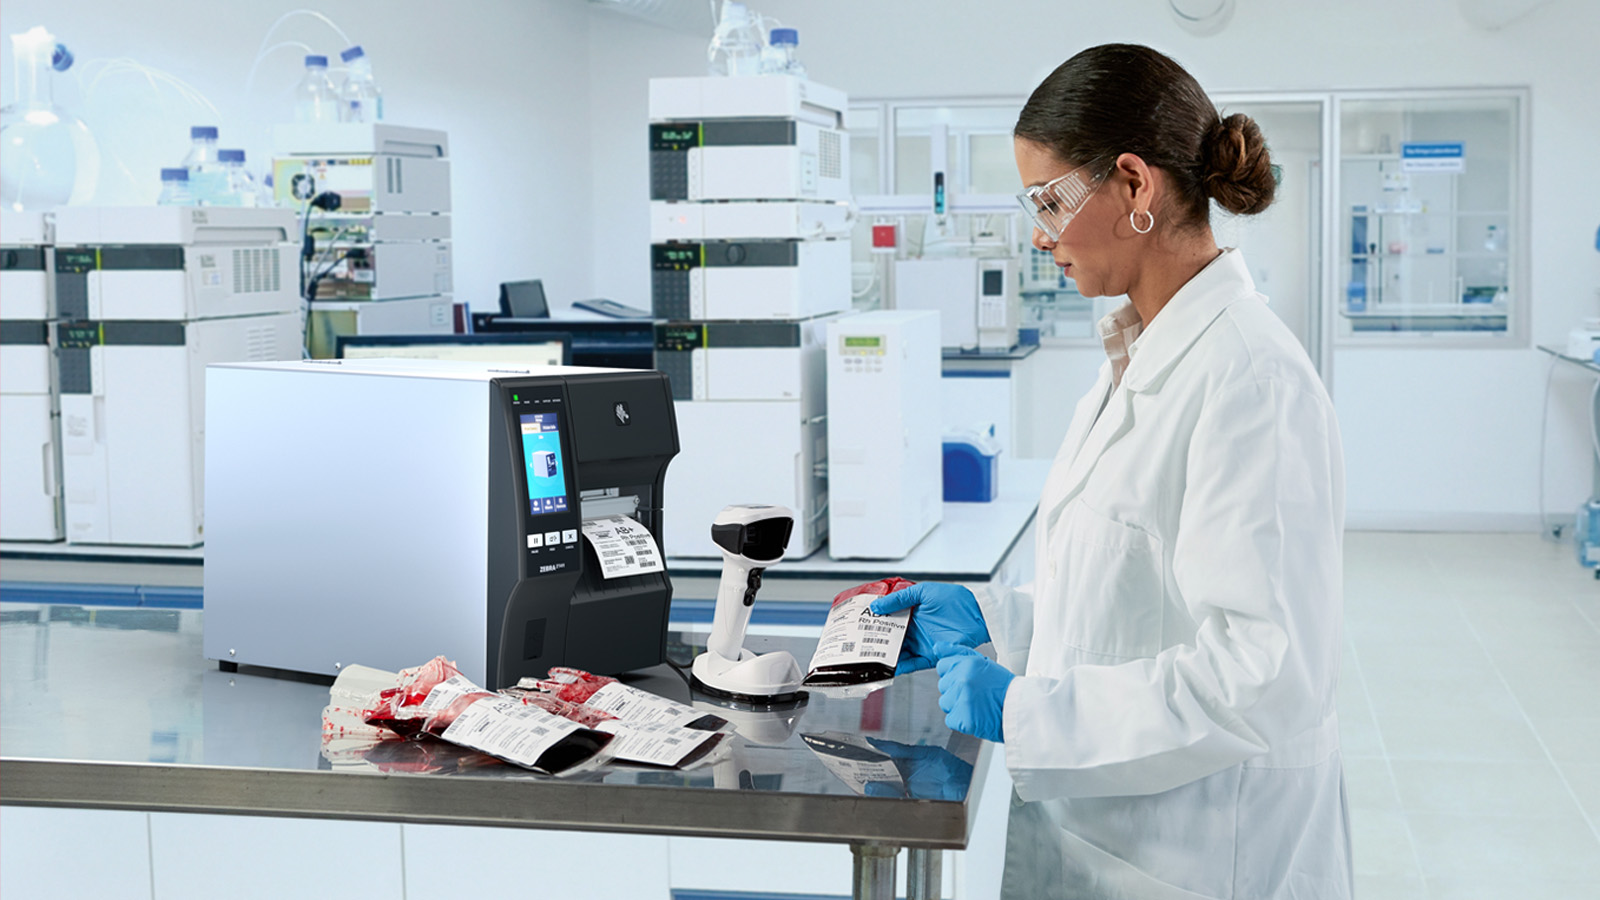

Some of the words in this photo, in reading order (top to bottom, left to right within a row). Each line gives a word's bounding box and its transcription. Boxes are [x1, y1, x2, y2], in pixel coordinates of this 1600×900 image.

[614, 526, 634, 535] AB+
[539, 564, 556, 573] ZEBRA
[873, 618, 906, 629] Positive
